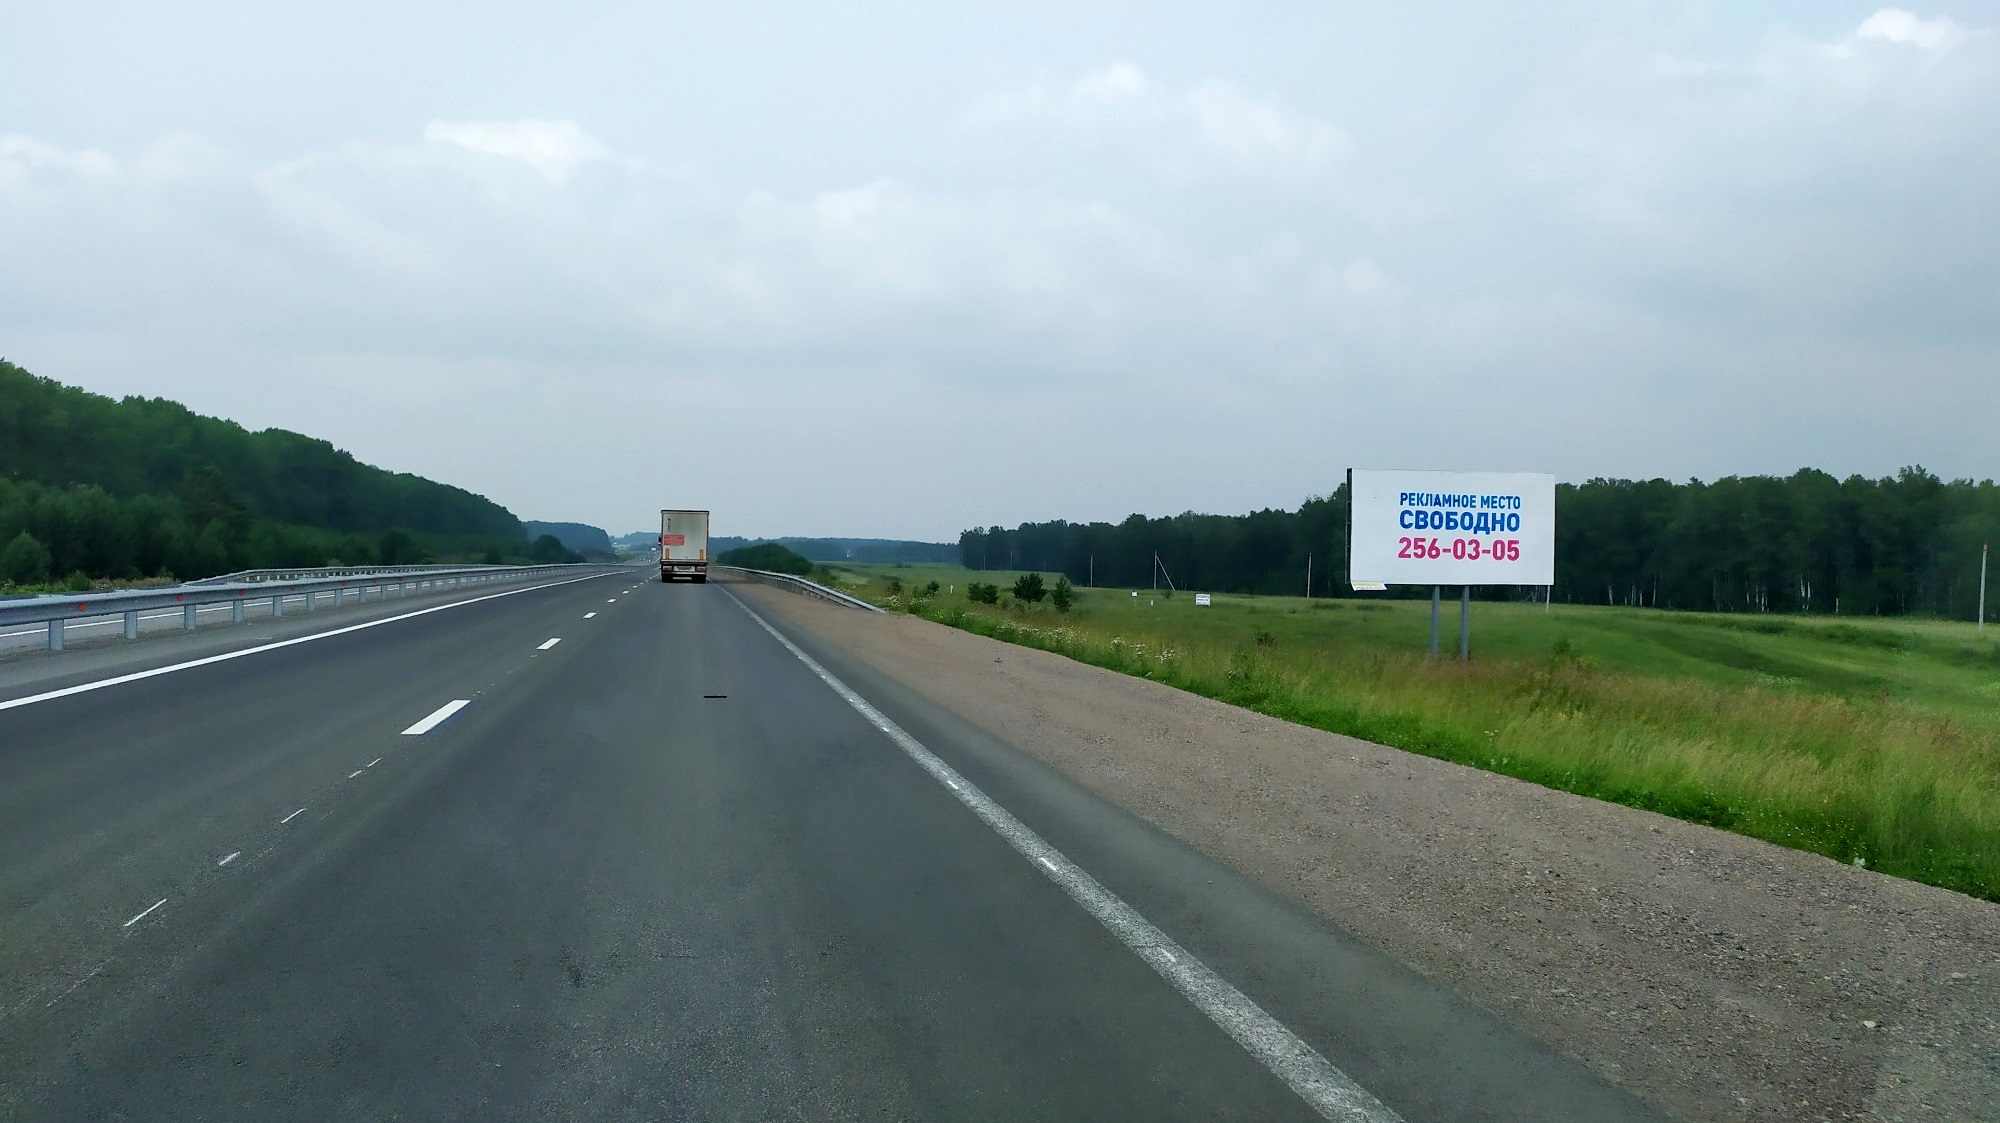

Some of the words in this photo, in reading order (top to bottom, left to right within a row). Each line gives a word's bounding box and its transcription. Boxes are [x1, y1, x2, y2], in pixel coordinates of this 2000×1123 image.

[1400, 492, 1476, 508] РЕКЛАМНОЕ
[1481, 495, 1520, 509] МЕСТО
[1400, 510, 1520, 535] СВОБОДНО
[1398, 537, 1520, 561] 256-03-05
